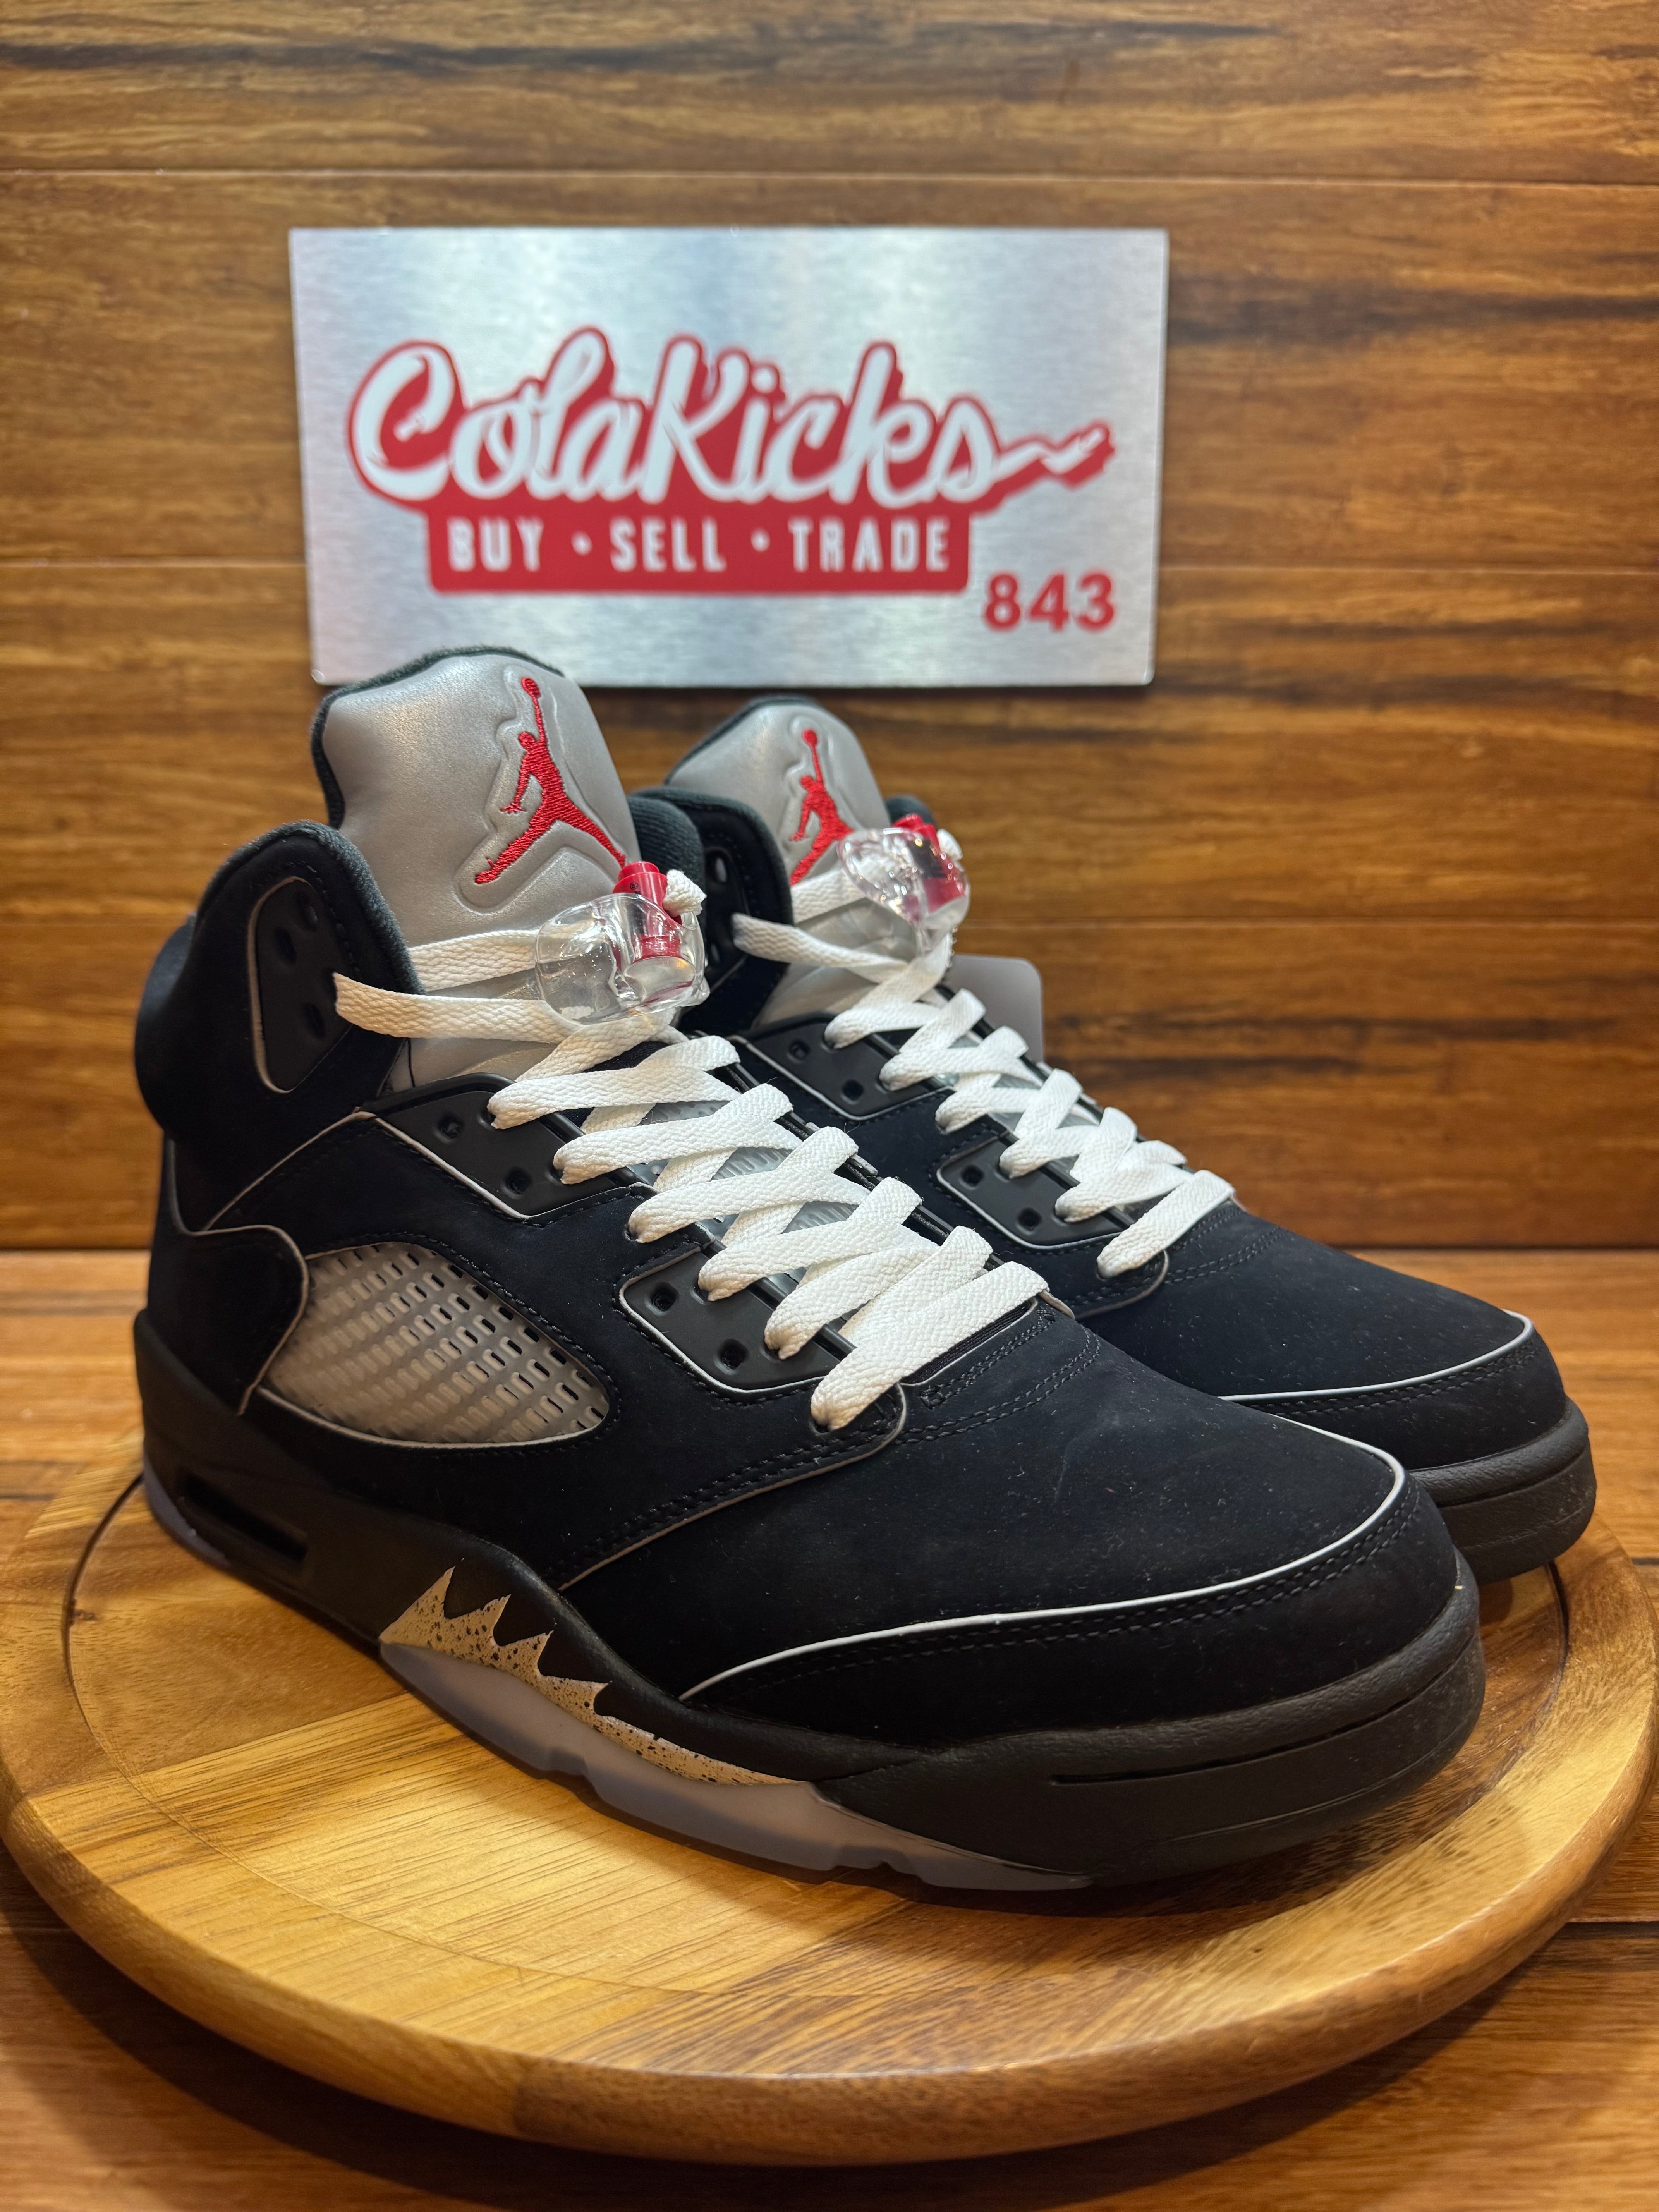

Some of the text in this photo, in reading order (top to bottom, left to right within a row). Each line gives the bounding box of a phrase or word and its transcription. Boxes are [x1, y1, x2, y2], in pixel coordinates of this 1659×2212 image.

[350, 328, 1108, 508] ColaKicks
[447, 517, 950, 572] BUY SELL TRADE
[984, 572, 1115, 632] 843
